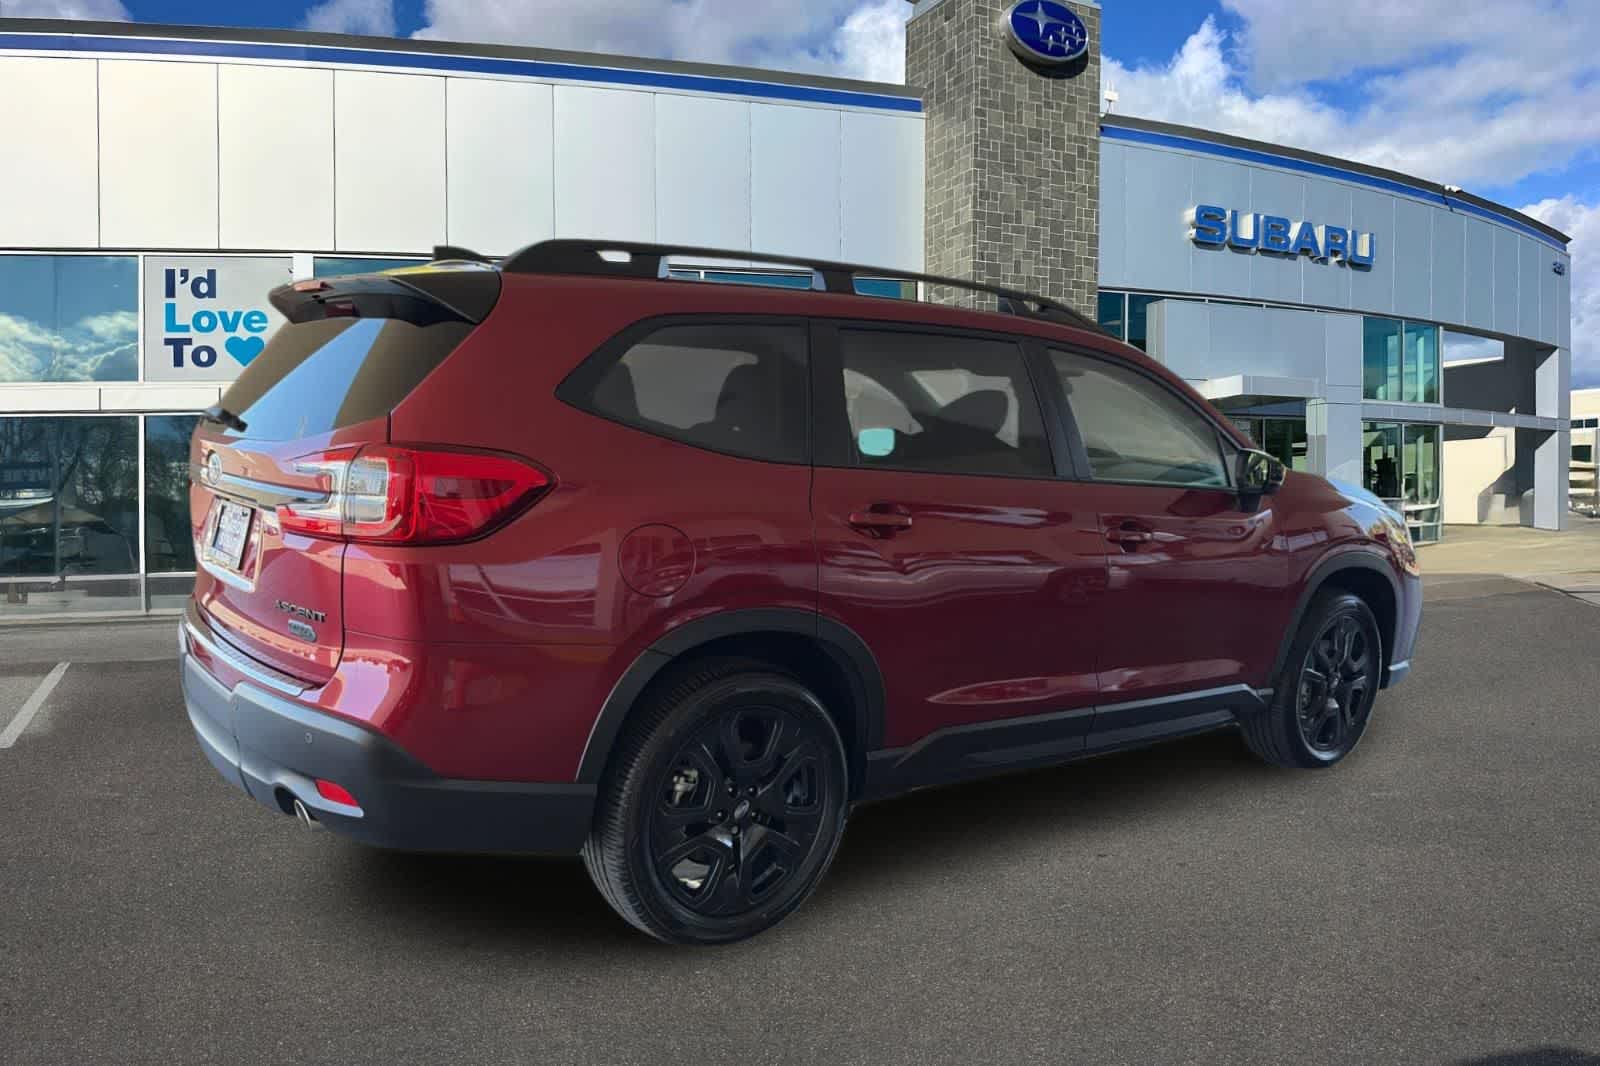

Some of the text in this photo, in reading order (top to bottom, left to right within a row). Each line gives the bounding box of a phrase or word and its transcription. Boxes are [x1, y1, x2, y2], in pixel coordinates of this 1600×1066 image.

[1190, 204, 1376, 269] SUBARU
[164, 268, 217, 299] I'd
[164, 302, 268, 333] Love
[163, 337, 217, 368] To
